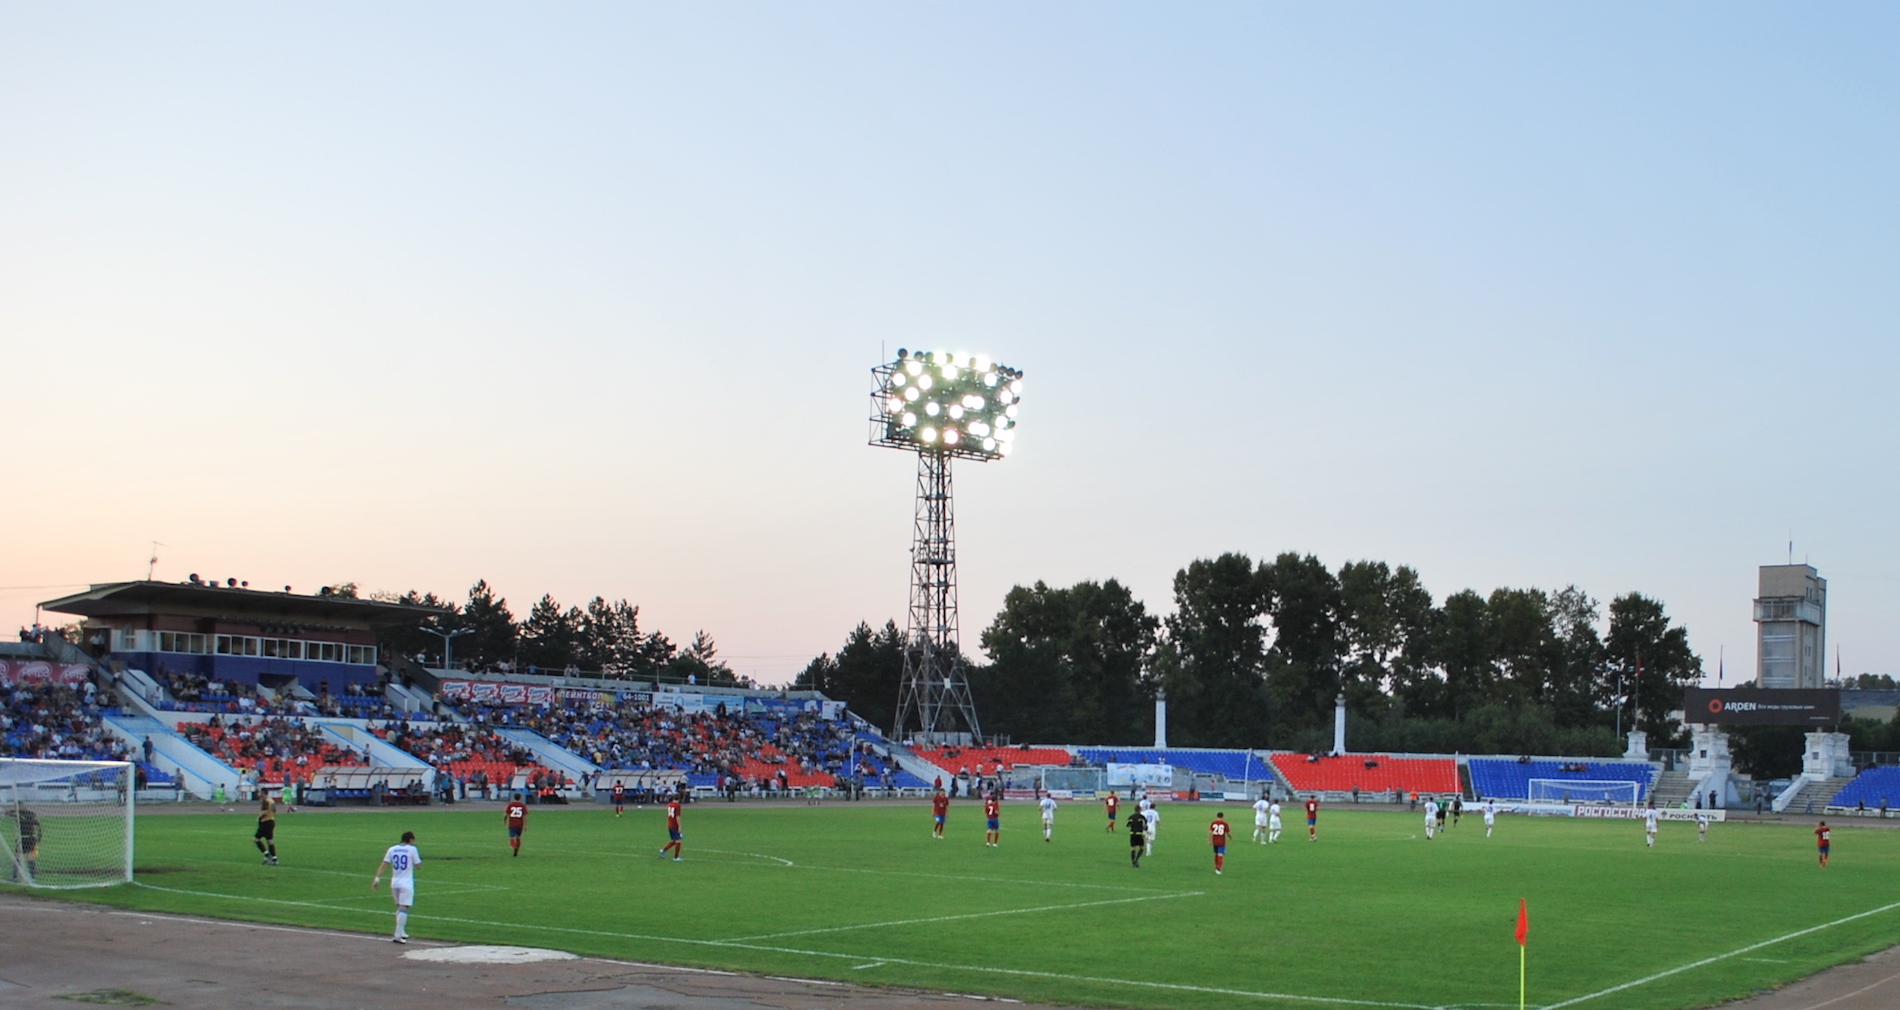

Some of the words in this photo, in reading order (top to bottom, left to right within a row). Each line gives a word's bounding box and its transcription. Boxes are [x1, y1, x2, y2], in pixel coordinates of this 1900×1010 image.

[559, 691, 604, 700] ПЕЙНТБОЛ
[622, 693, 650, 702] 64-1001
[1724, 702, 1757, 713] ARDEN
[510, 806, 523, 818] 25
[988, 806, 994, 815] 7
[1577, 805, 1651, 819] РОСГОССТРА
[1669, 812, 1717, 820] РОСНТЬ
[1212, 824, 1225, 835] 26
[392, 854, 408, 871] 39
